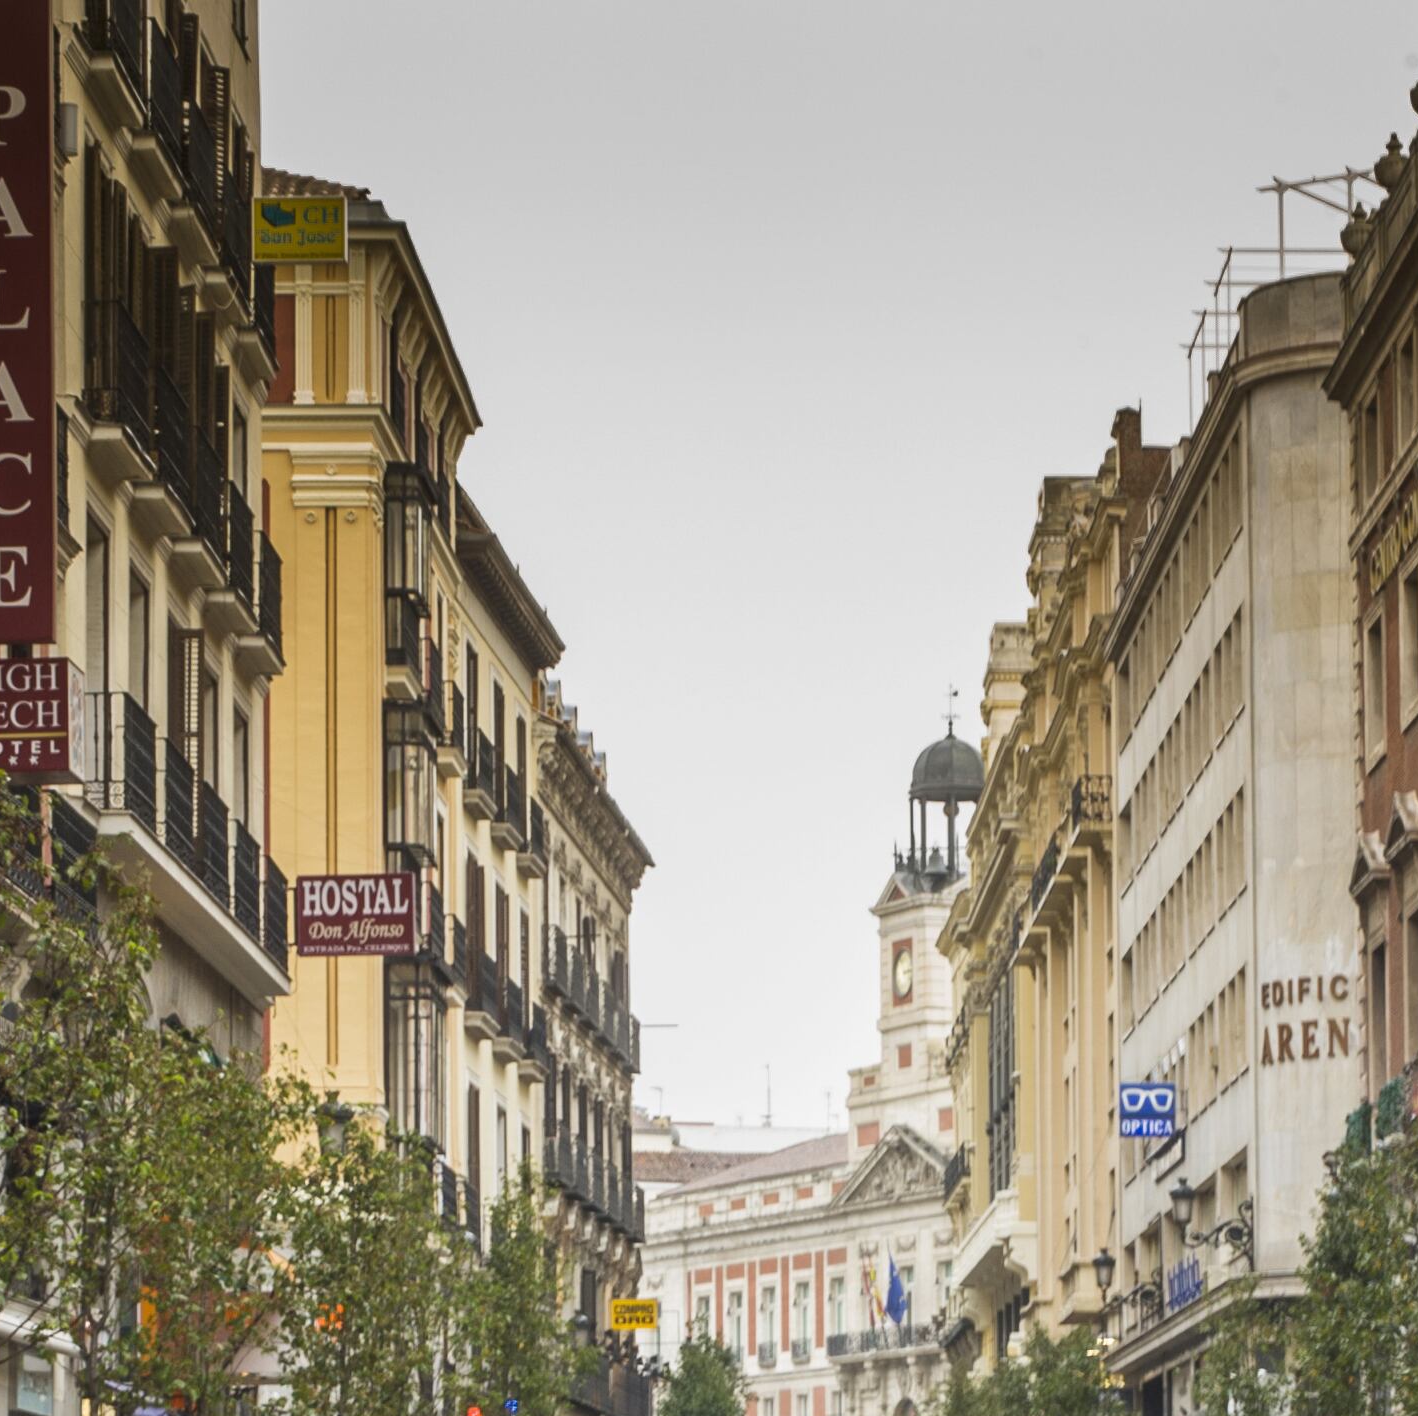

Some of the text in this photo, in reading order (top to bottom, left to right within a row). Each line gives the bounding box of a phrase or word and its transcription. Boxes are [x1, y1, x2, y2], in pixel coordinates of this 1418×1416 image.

[303, 207, 339, 225] CH
[302, 879, 409, 916] HOSTAL
[308, 917, 404, 945] Don Alfonso
[1121, 1118, 1174, 1135] OPTICA
[614, 1304, 653, 1313] COMPRO
[615, 1314, 654, 1324] ORO
